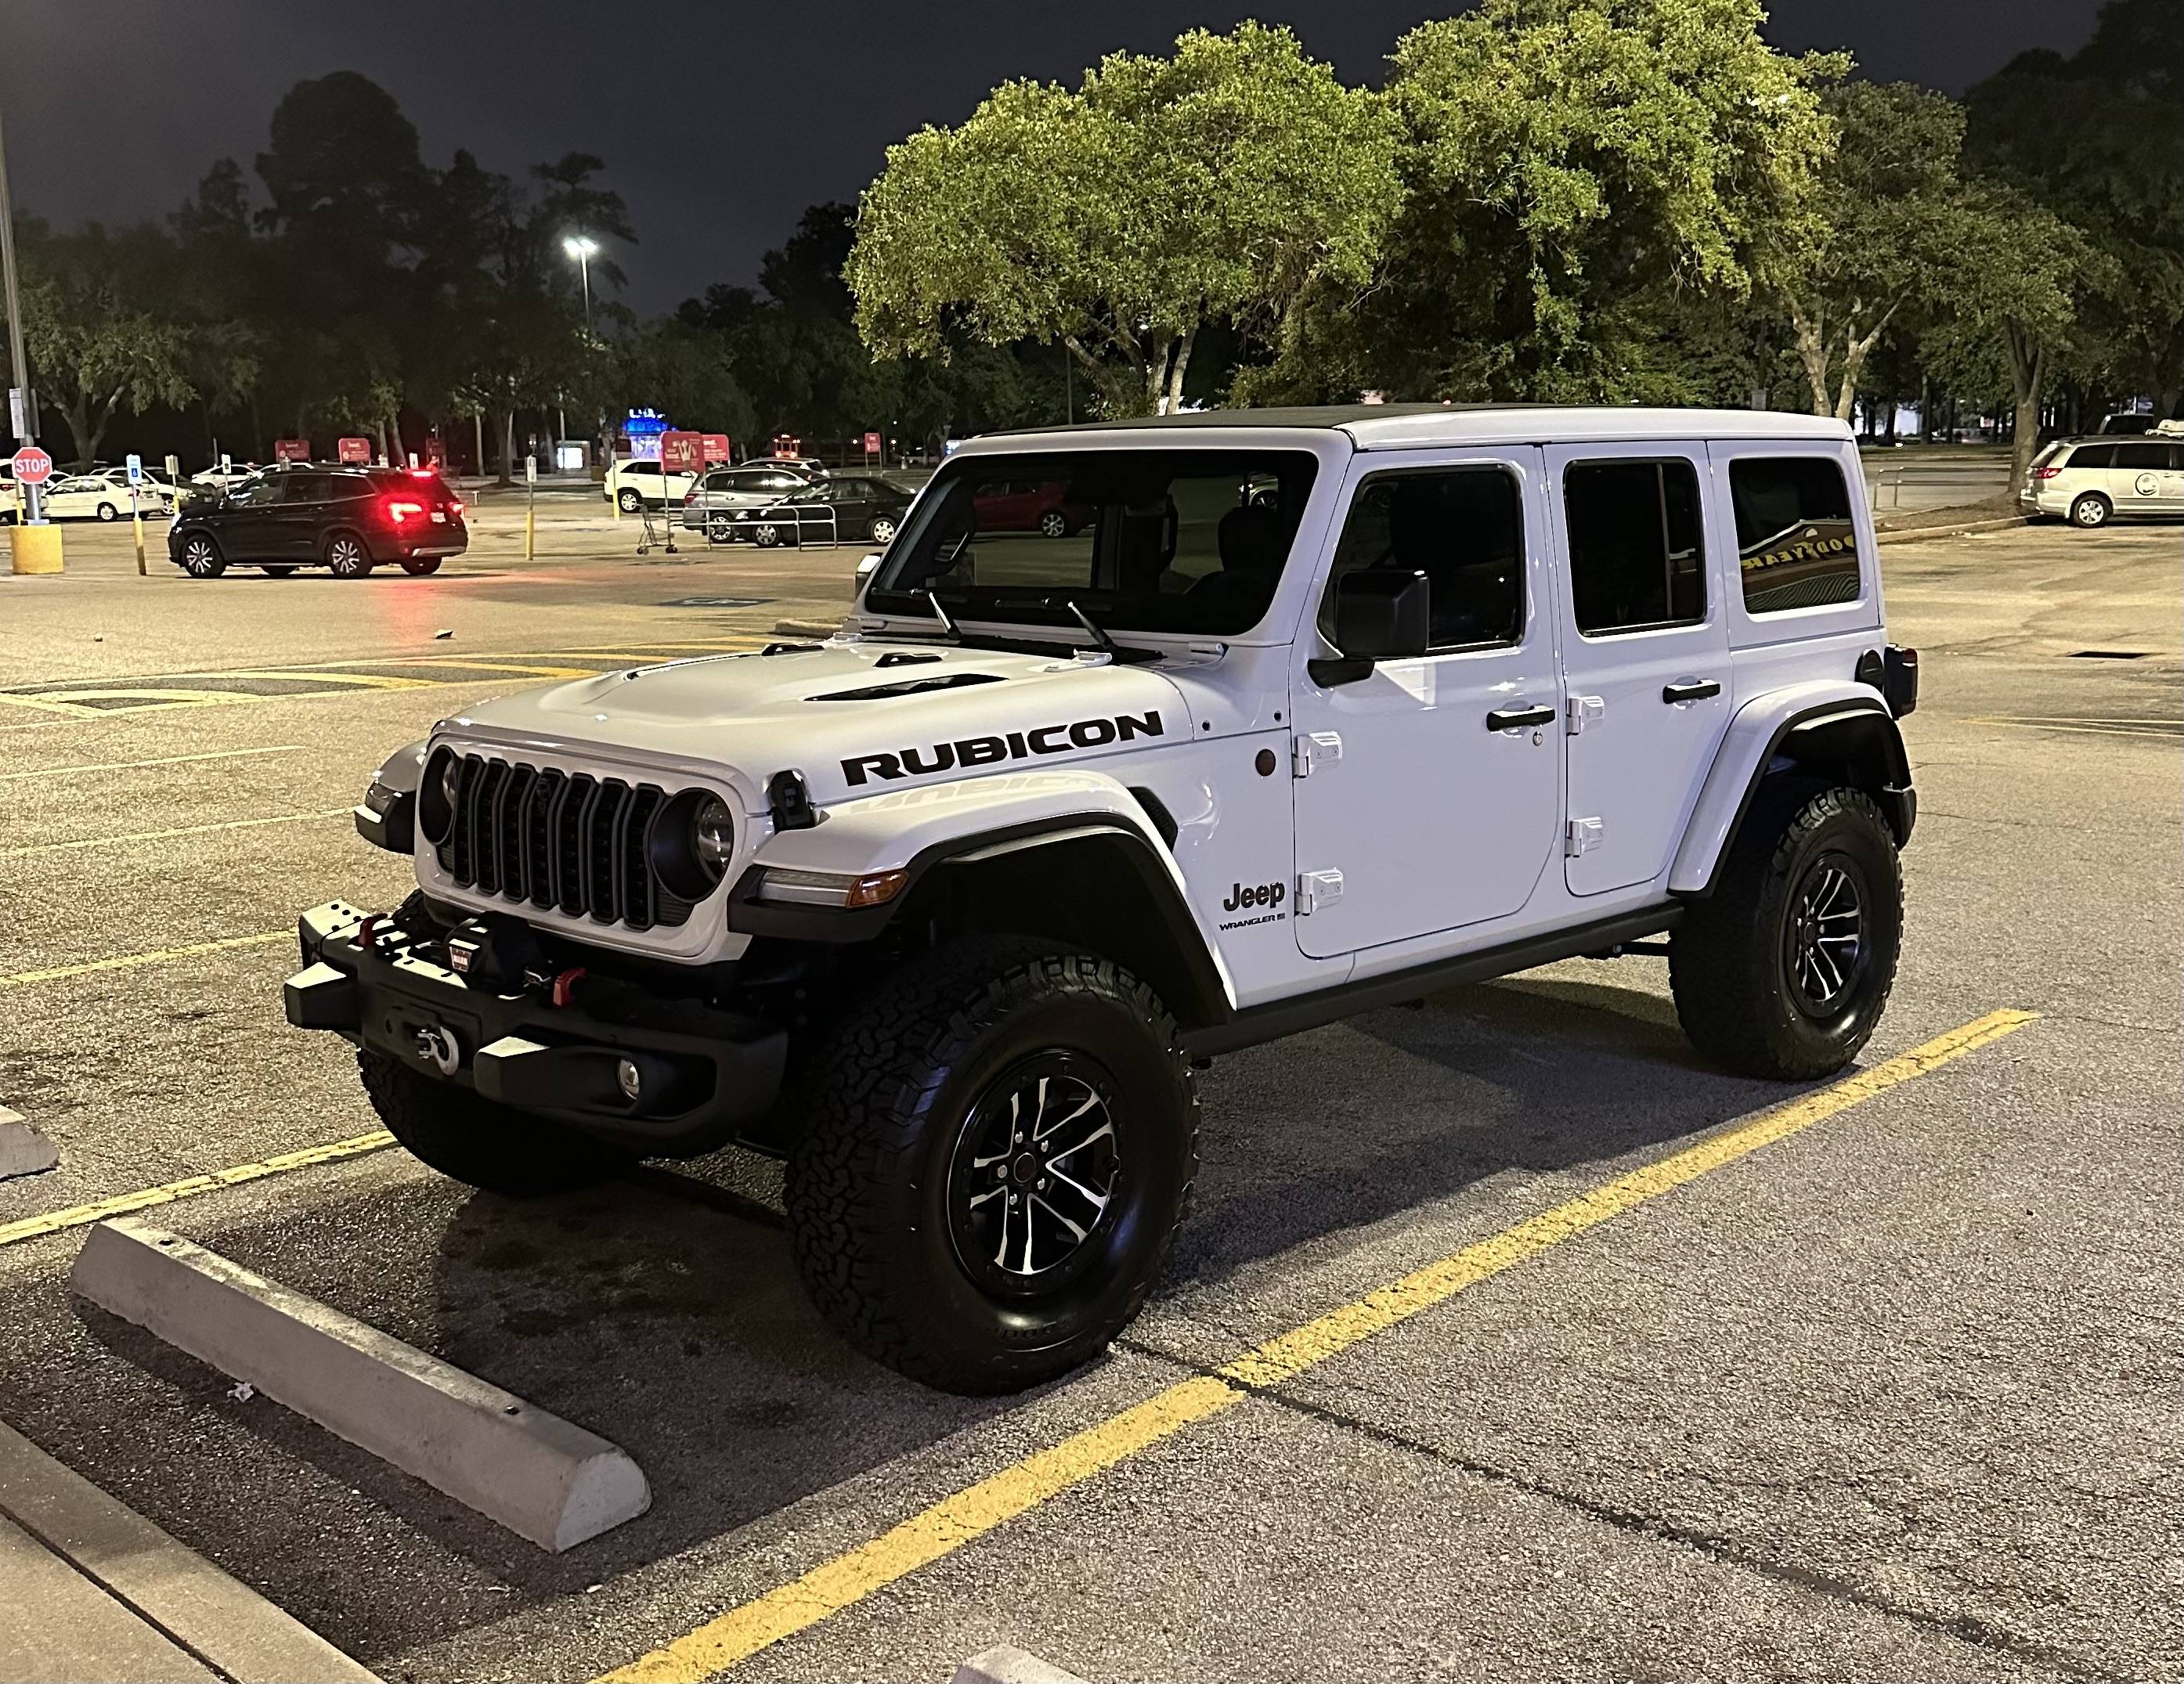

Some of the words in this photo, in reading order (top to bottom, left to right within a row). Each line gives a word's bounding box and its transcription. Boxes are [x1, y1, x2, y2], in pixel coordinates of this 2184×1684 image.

[16, 459, 49, 474] STOP
[840, 710, 1164, 787] RUBICON
[1223, 882, 1285, 912] Jeep
[1219, 914, 1276, 931] WRANGLER
